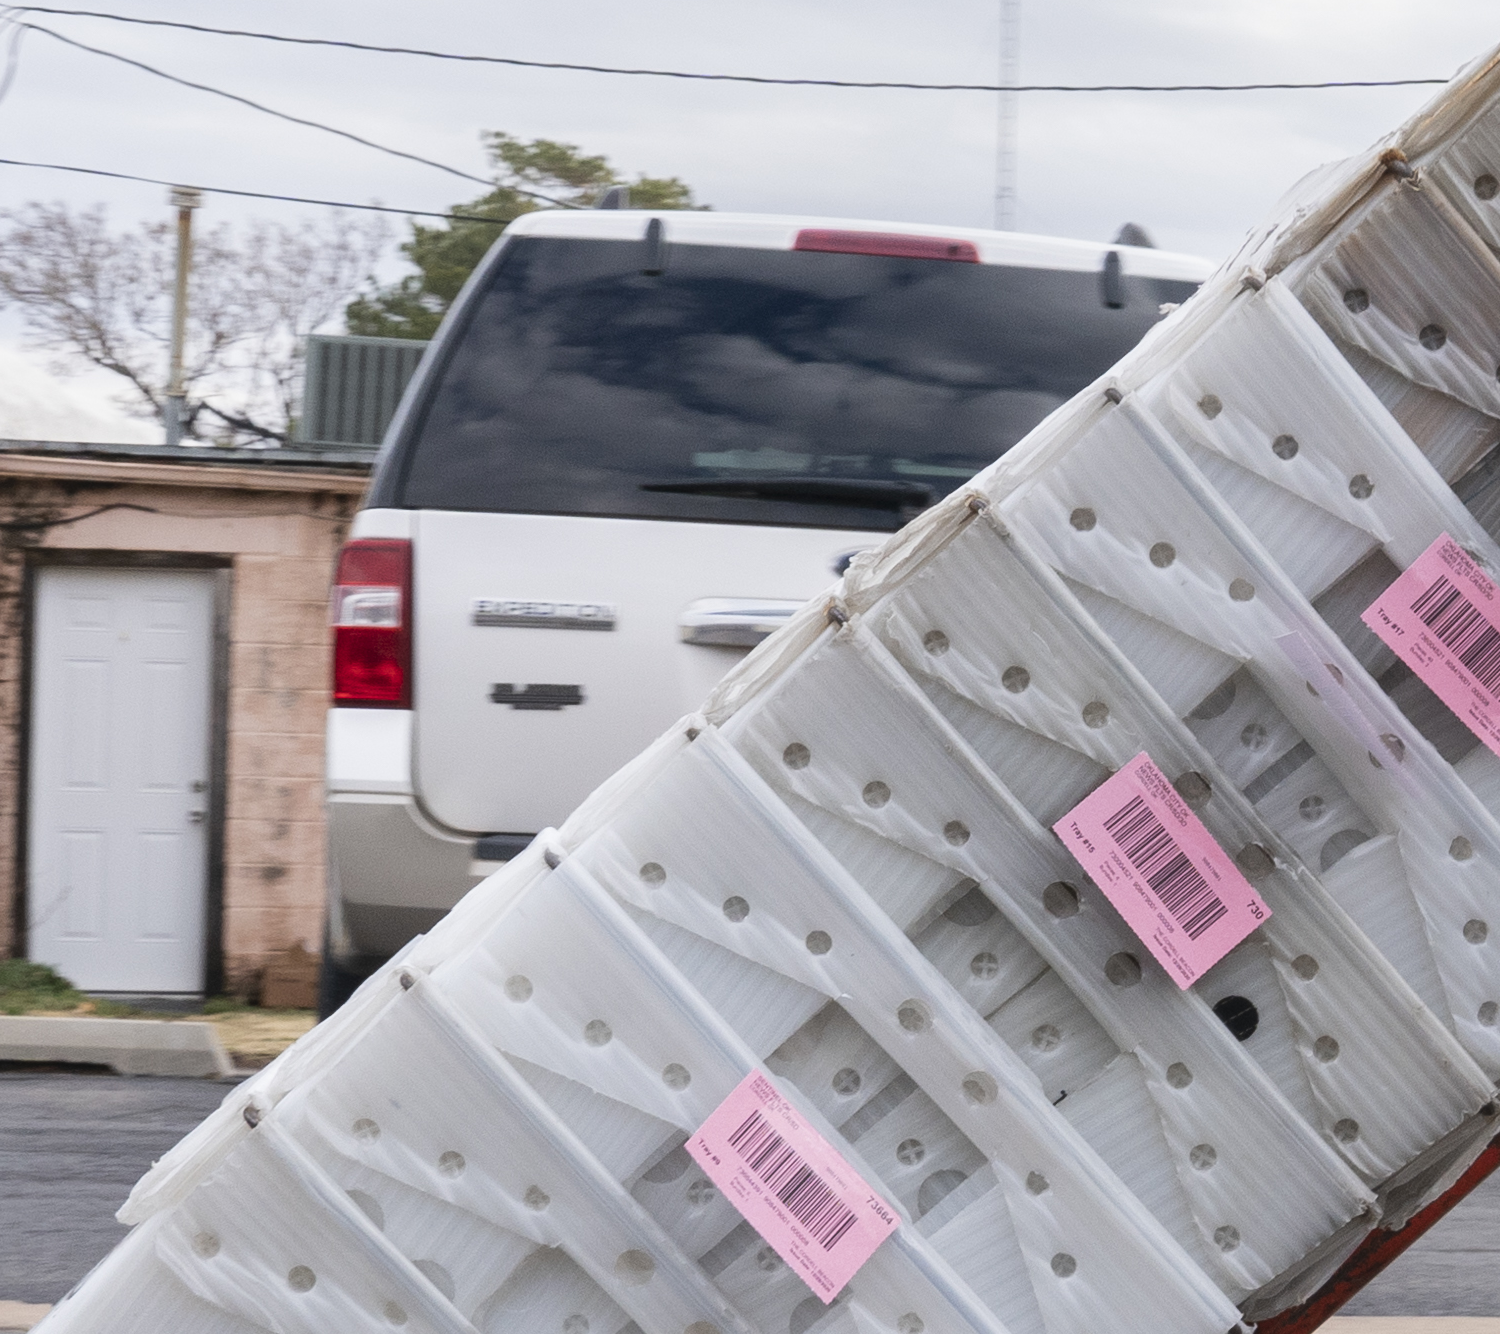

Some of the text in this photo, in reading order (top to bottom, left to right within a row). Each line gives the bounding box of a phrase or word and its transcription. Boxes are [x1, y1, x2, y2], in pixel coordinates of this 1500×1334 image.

[1440, 546, 1456, 562] NEWS
[1456, 562, 1469, 576] FLTS
[1445, 541, 1494, 592] OKLAHOMA CITY OK
[1375, 608, 1404, 636] Tray #17
[1138, 766, 1154, 784] NEWS
[1153, 785, 1165, 799] FLTS
[1144, 761, 1189, 818] OKLAHOMA CITY OK
[1068, 822, 1094, 852] Tray #15
[1246, 900, 1264, 920] 730
[753, 1080, 769, 1098] NEWS
[768, 1097, 782, 1112] FLTS
[757, 1075, 791, 1112] SENTINEL OK
[697, 1139, 721, 1166] Tray #9
[866, 1195, 893, 1225] 73664
